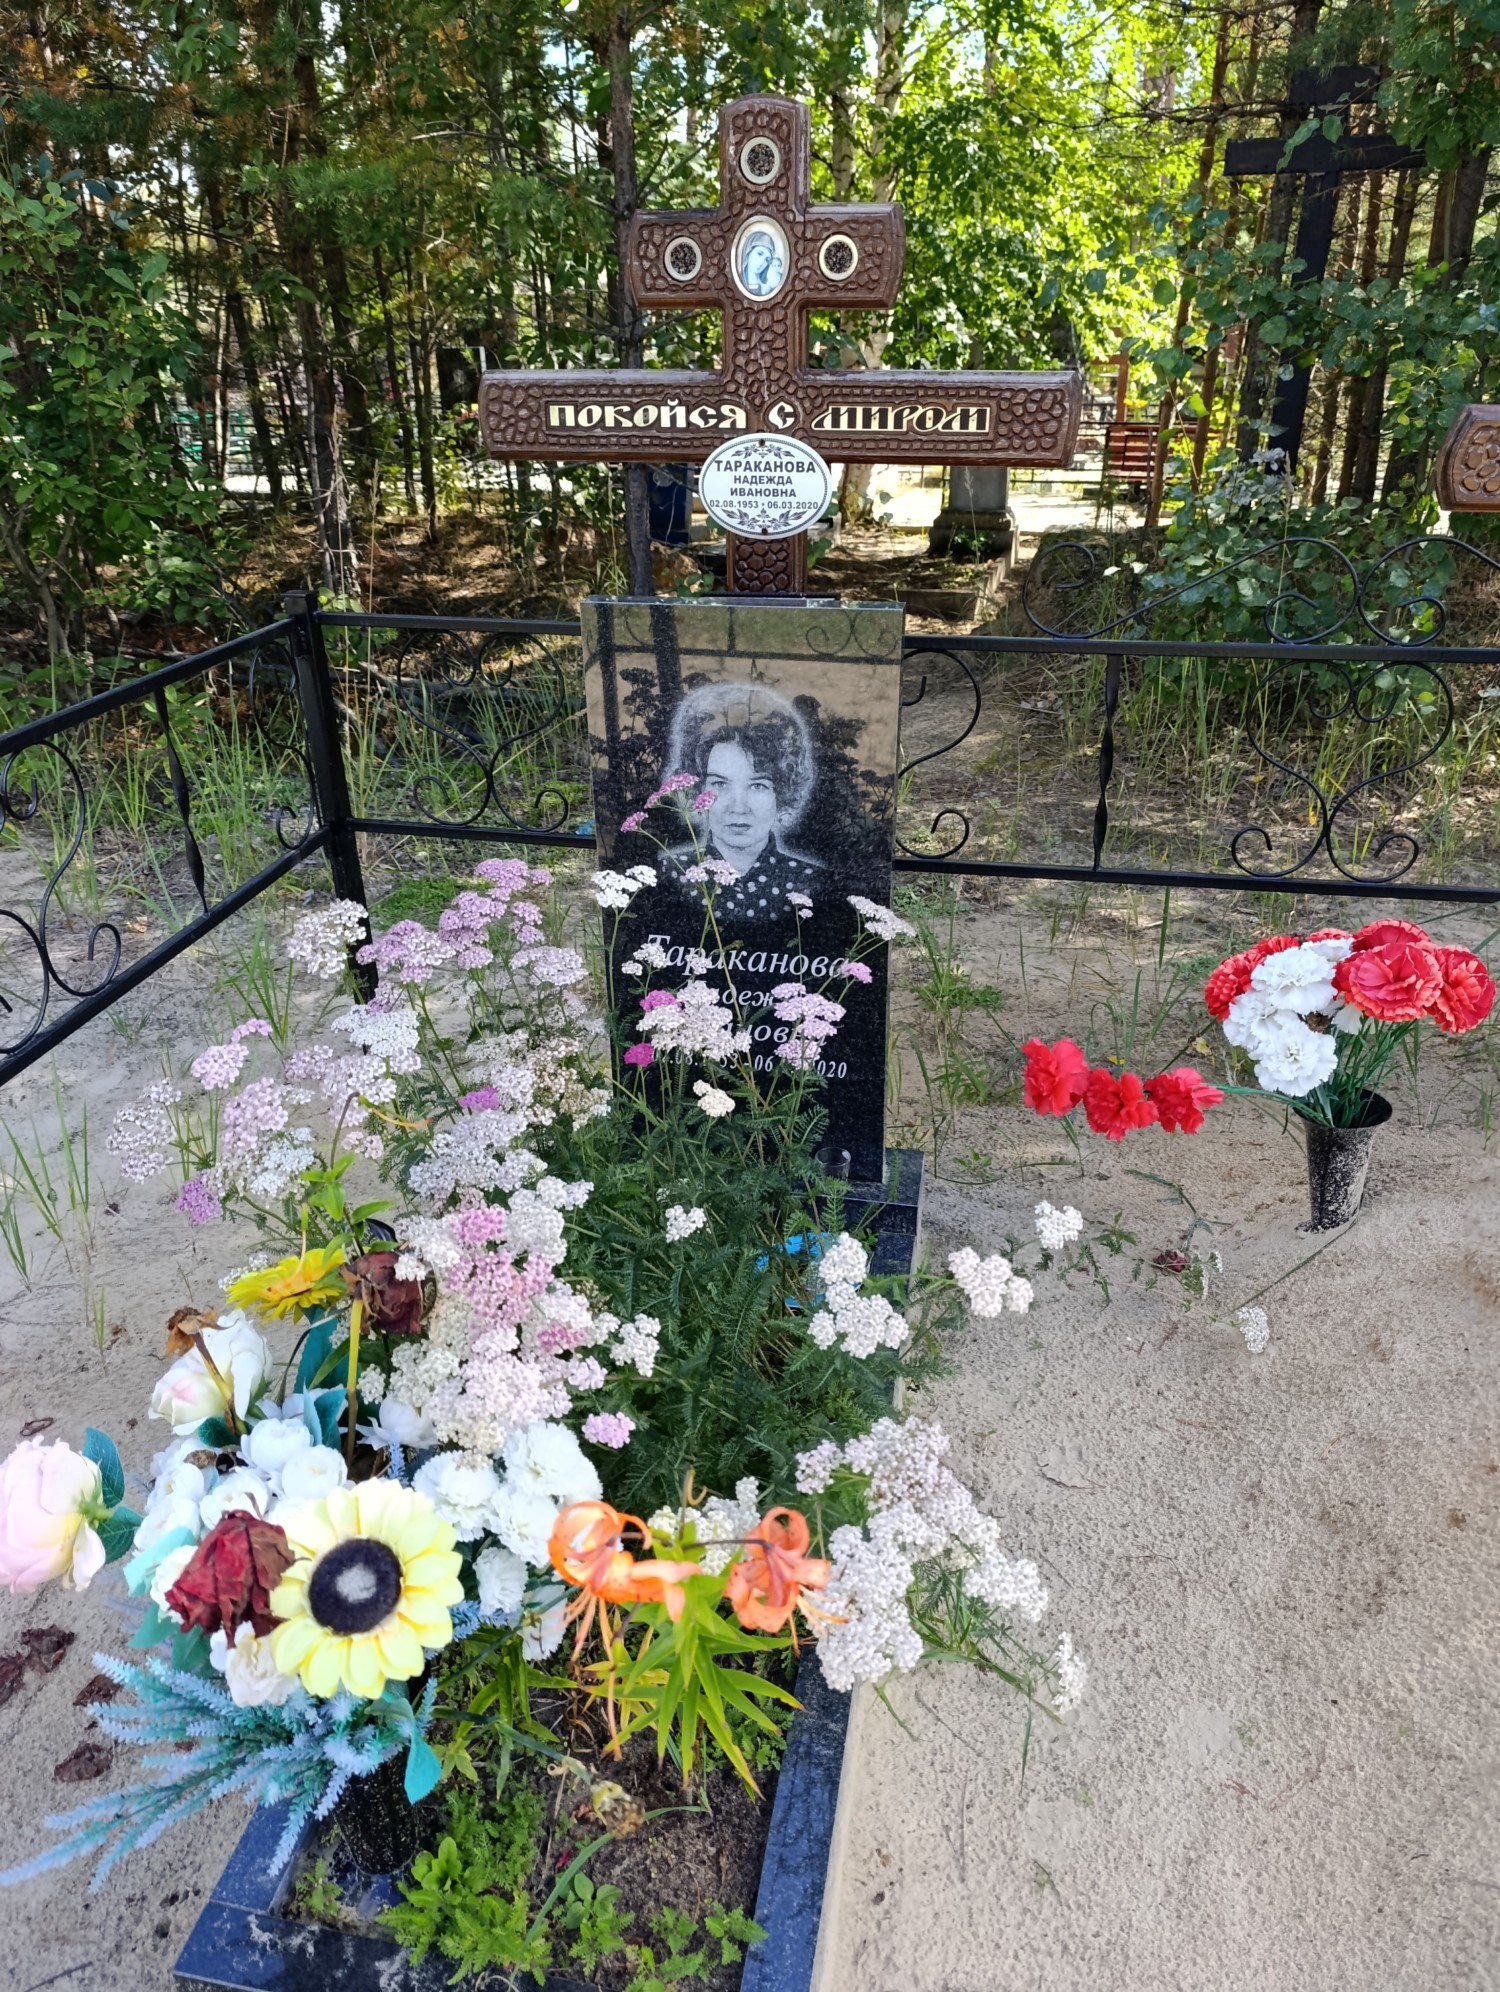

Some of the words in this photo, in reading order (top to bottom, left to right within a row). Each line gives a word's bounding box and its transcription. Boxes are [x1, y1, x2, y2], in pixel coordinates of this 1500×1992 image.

[549, 399, 747, 429] ПОКОЙСЯ
[714, 460, 816, 473] ТАРАКАНОВА
[733, 475, 793, 486] НАДЕЖДА
[730, 487, 797, 498] ИВАНОВНА
[709, 500, 759, 508] 02.08.1953
[767, 501, 819, 509] 06.03.2020
